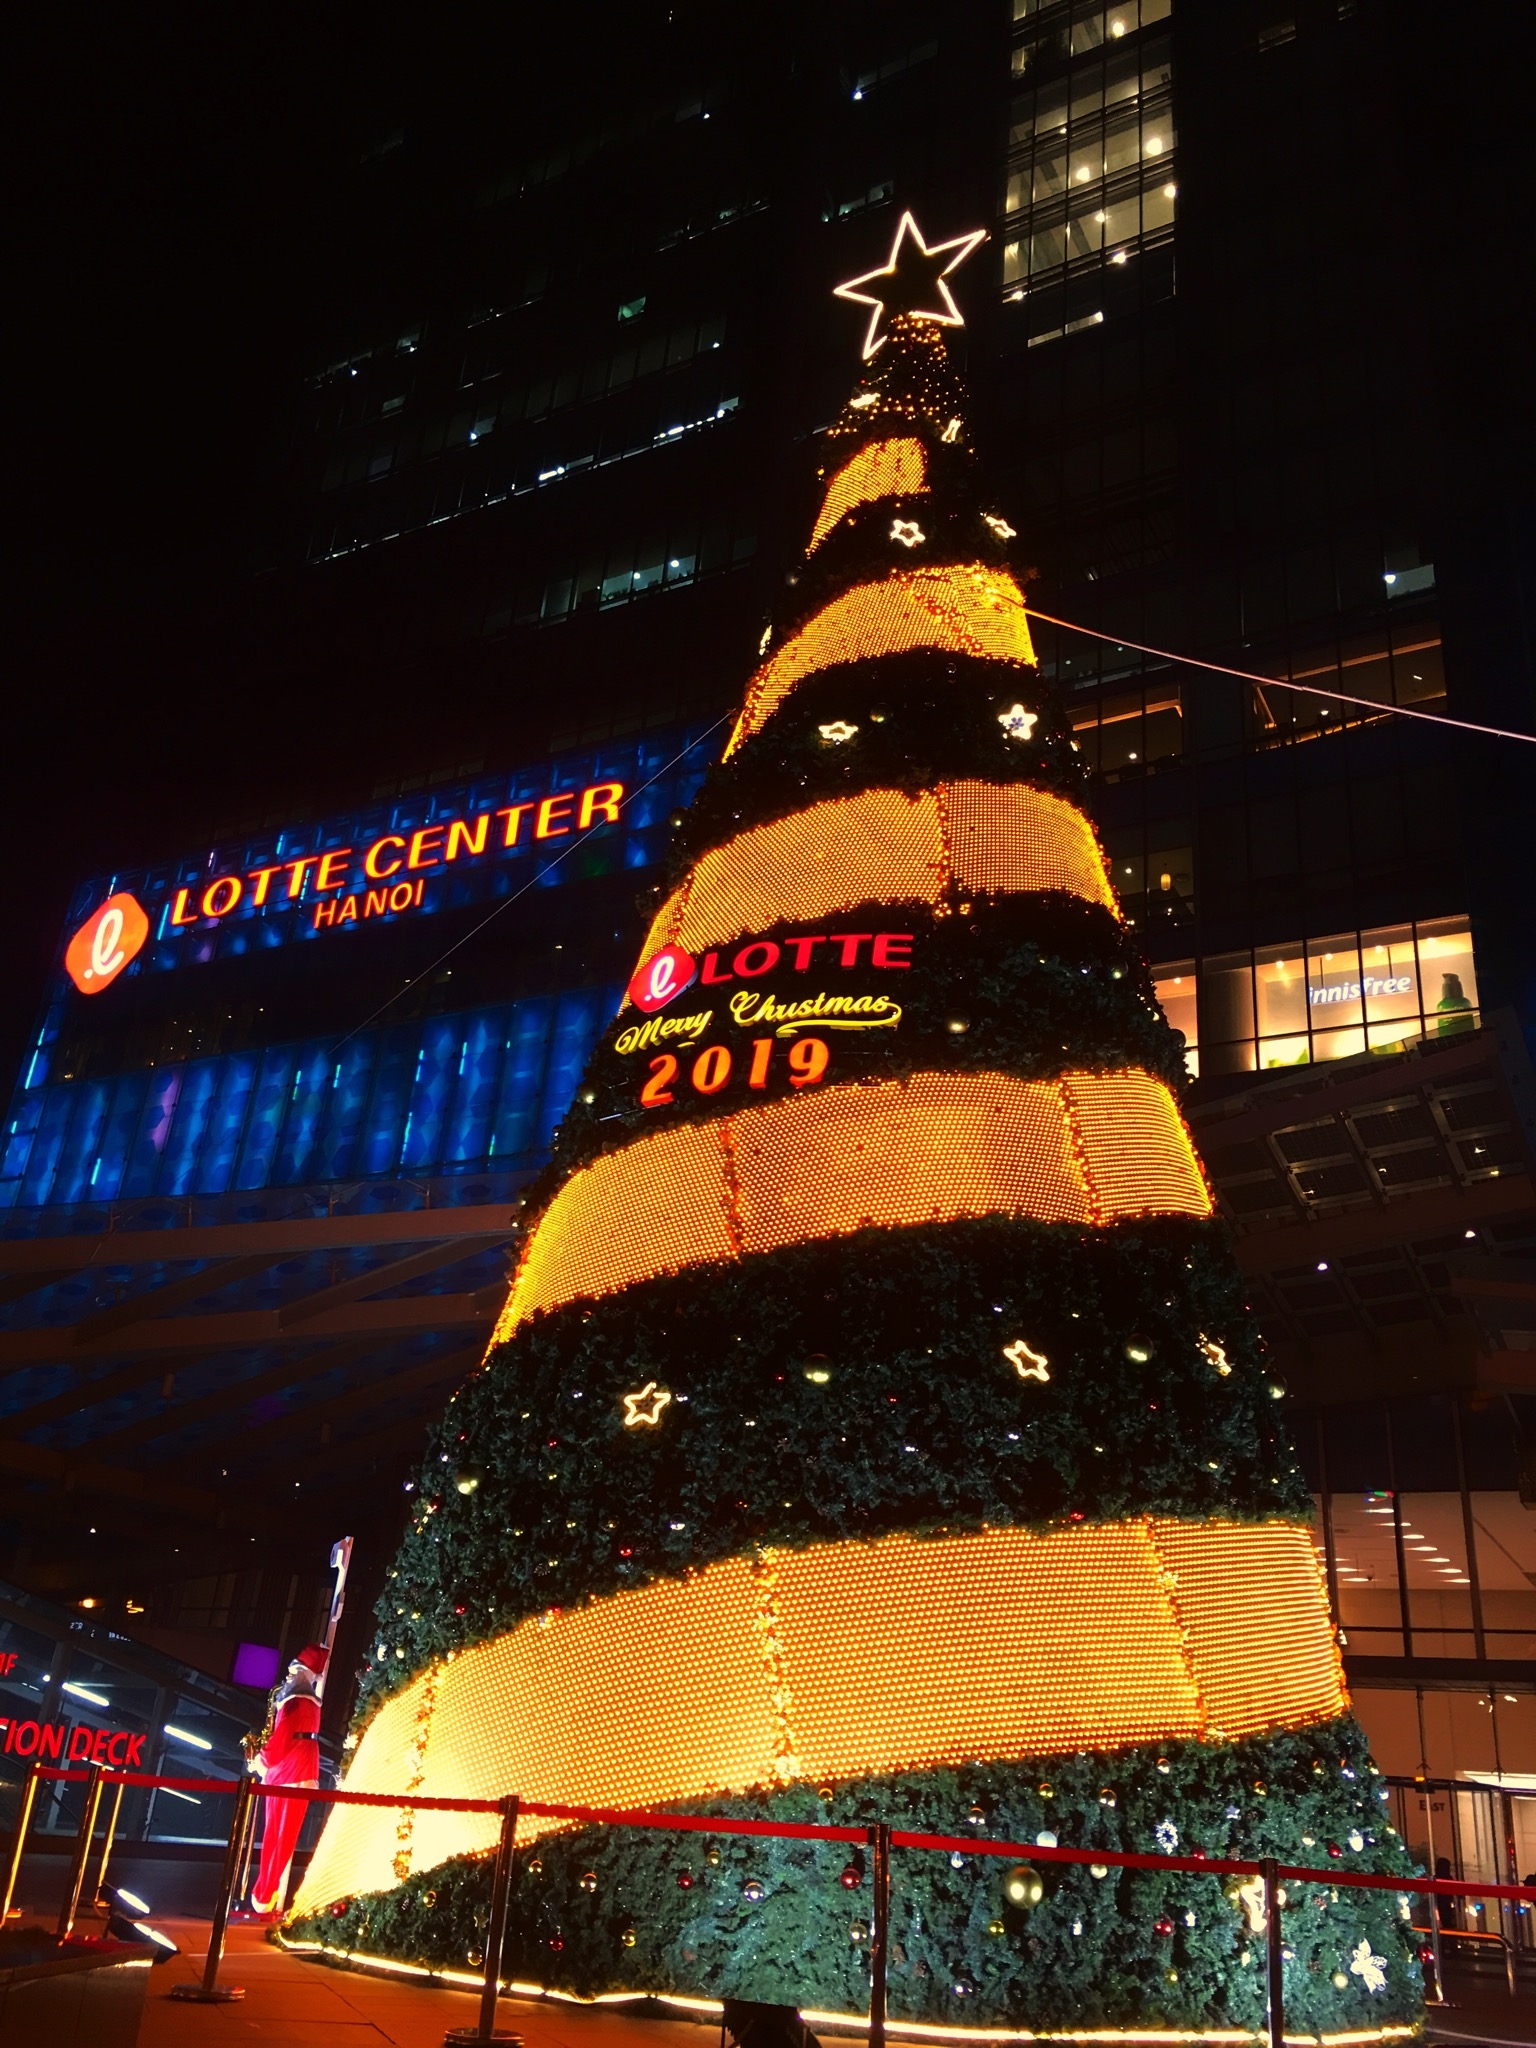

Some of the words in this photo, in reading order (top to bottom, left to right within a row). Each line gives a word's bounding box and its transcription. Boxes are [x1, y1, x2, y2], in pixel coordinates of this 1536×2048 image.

[170, 847, 351, 926] LOTTE
[364, 782, 624, 879] CENTER
[313, 878, 426, 929] HANOI
[701, 934, 914, 985] LOTTE
[1309, 976, 1411, 1004] innisfree
[614, 1010, 713, 1055] Merry
[729, 990, 902, 1038] Christmas
[640, 1038, 830, 1106] 2019
[68, 1726, 147, 1767] DECK
